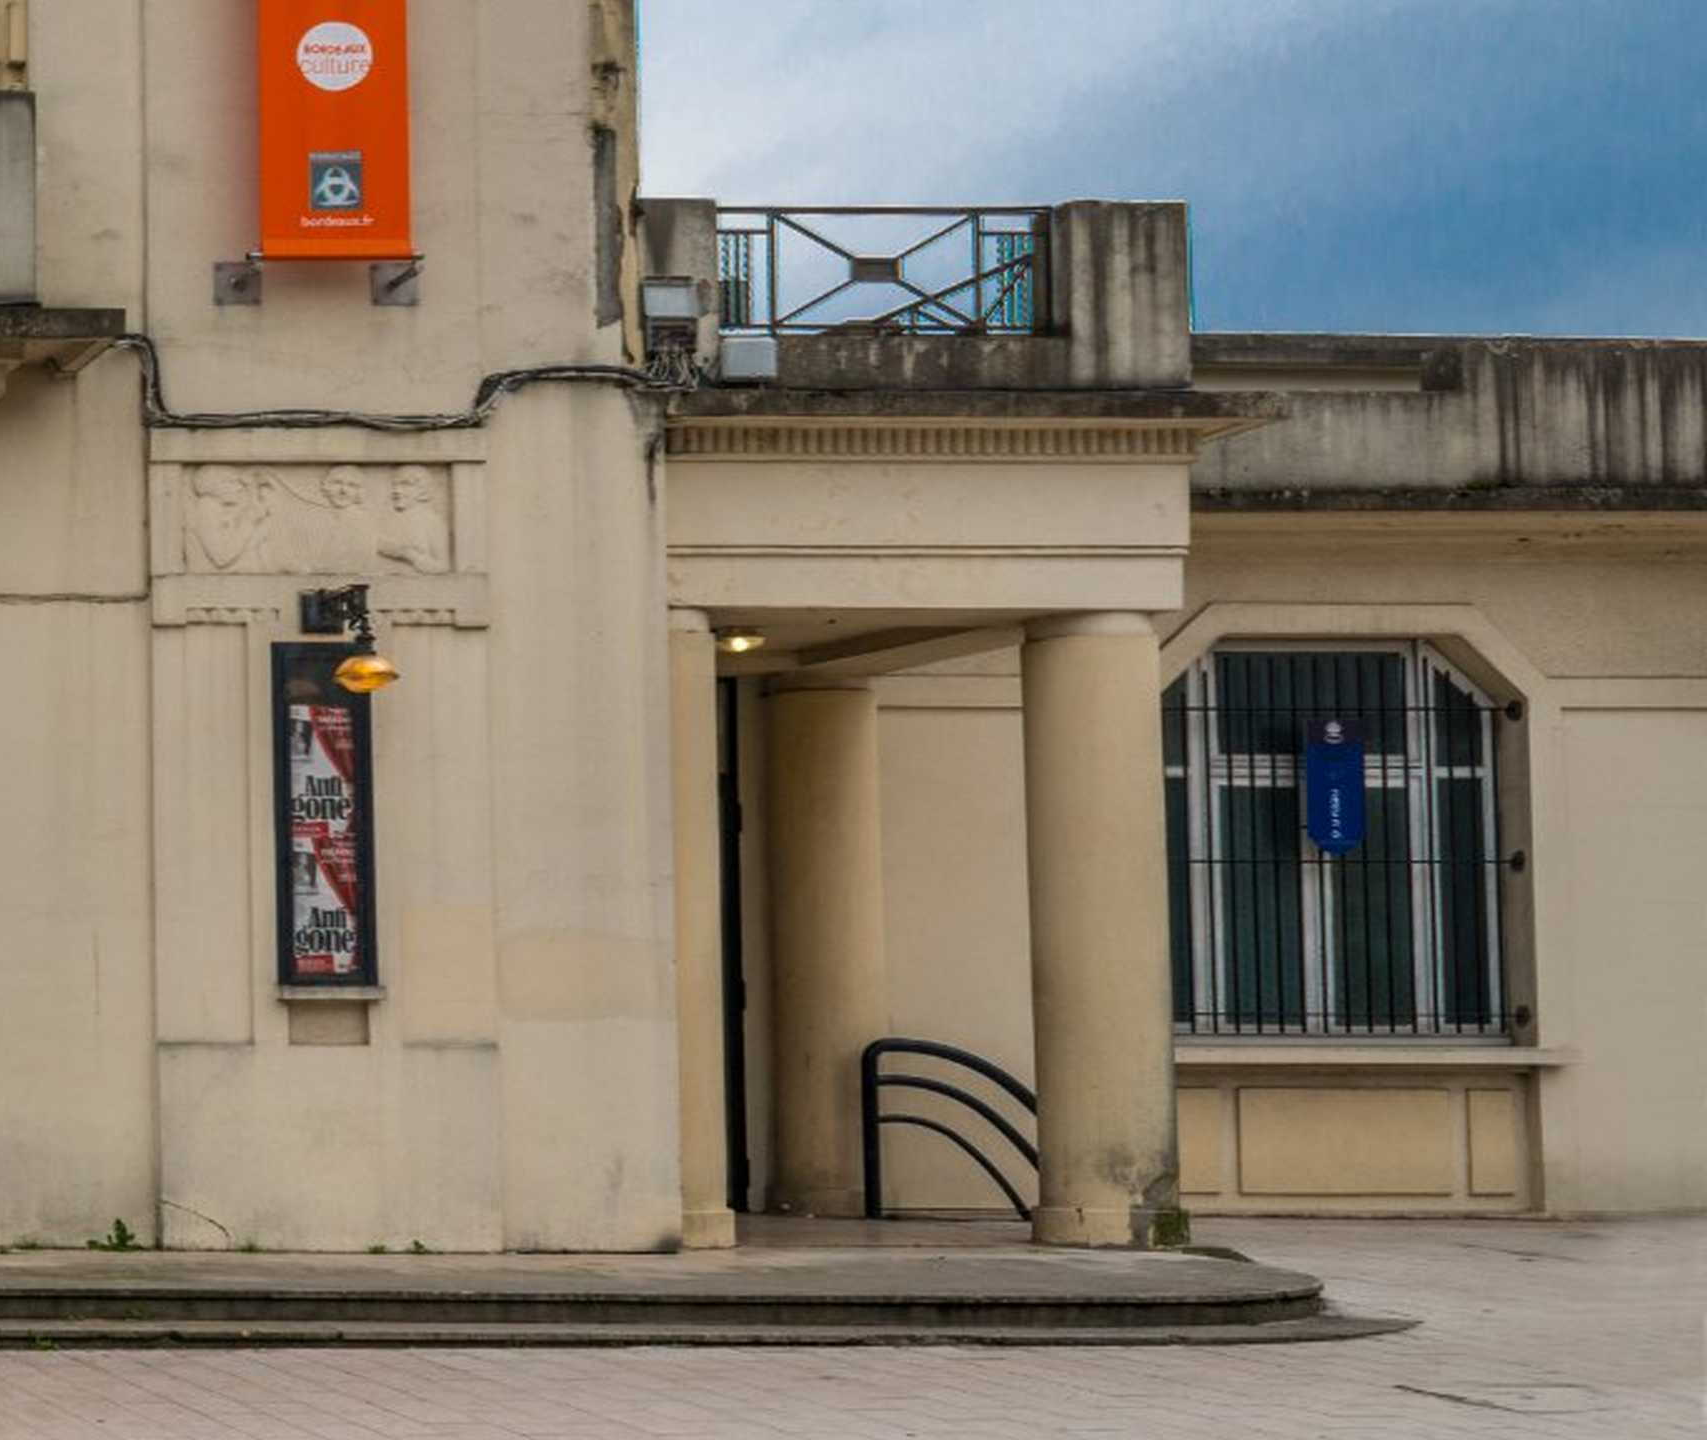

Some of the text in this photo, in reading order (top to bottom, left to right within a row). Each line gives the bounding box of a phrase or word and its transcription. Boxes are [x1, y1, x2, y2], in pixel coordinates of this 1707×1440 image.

[299, 58, 370, 74] culture
[305, 774, 342, 796] Anti
[291, 795, 350, 822] gone
[308, 906, 347, 928] Anti
[294, 926, 354, 954] gone
